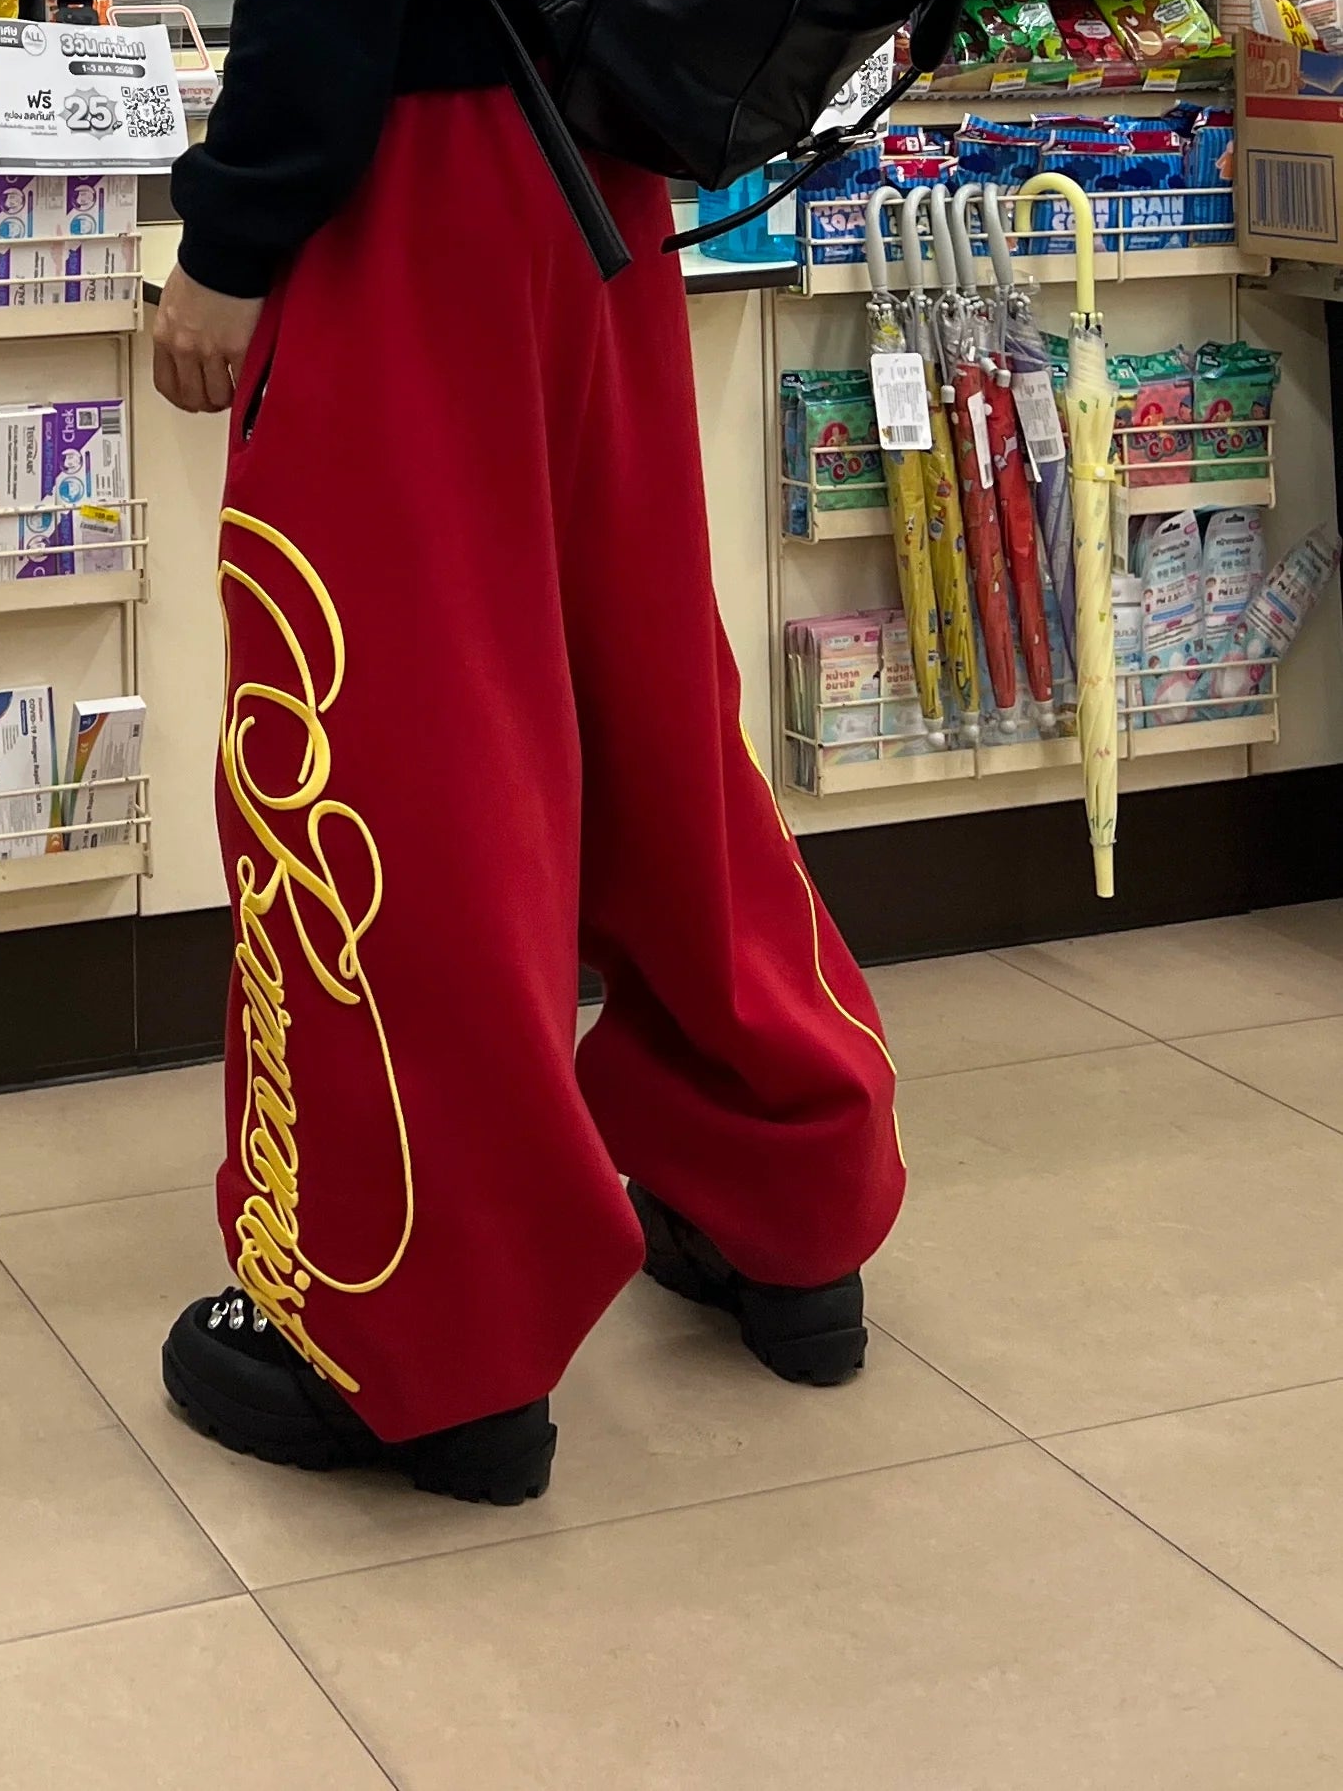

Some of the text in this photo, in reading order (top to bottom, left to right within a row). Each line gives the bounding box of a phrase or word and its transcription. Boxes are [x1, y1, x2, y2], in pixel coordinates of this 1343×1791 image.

[25, 31, 43, 43] ALL
[27, 89, 52, 109] ฟรี
[23, 111, 55, 120] ลดทันที
[1132, 196, 1184, 214] RAIN
[1131, 214, 1183, 230] COAT
[62, 409, 75, 442] Chek
[826, 670, 859, 680] หน้ากาก
[826, 681, 855, 691] อนามัย
[28, 698, 38, 735] COVID-19
[31, 736, 39, 766] Antigen
